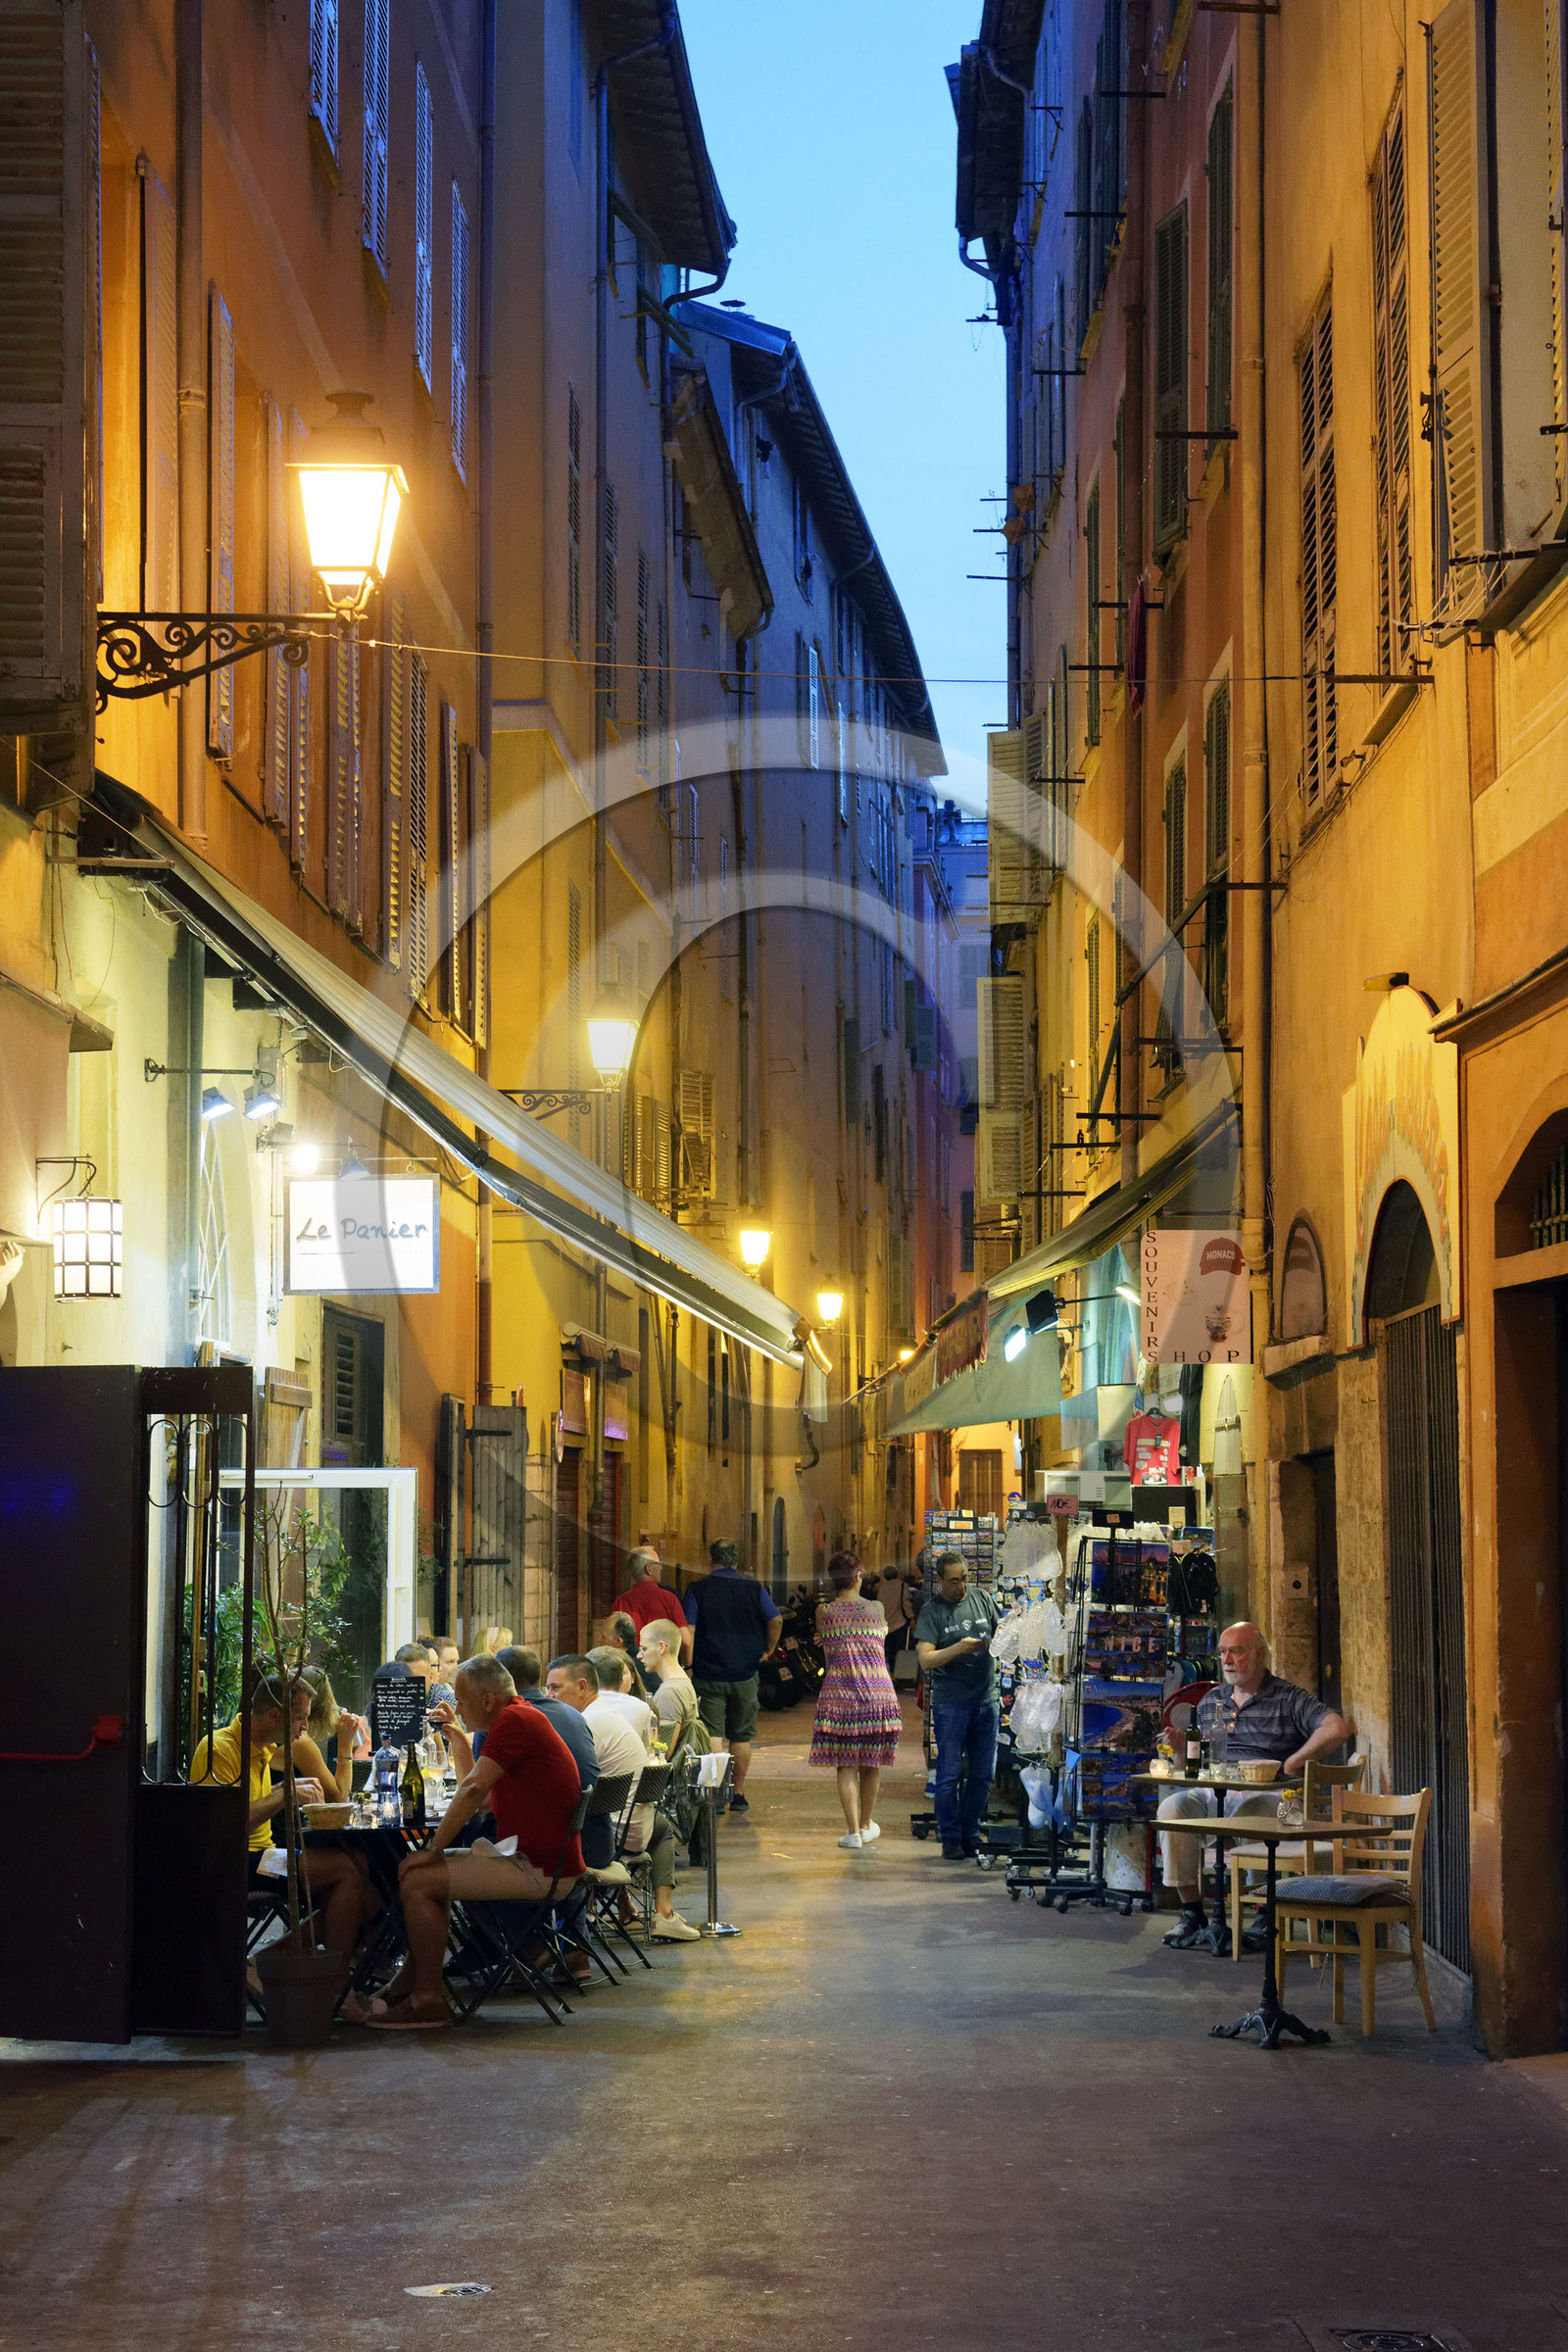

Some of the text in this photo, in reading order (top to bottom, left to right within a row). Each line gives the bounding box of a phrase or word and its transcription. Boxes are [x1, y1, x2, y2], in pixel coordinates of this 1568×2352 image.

[296, 1217, 428, 1243] Le Panier
[1206, 1250, 1236, 1260] MONACO
[1145, 1231, 1159, 1363] SOUVENIRS
[1104, 1635, 1155, 1653] NICE
